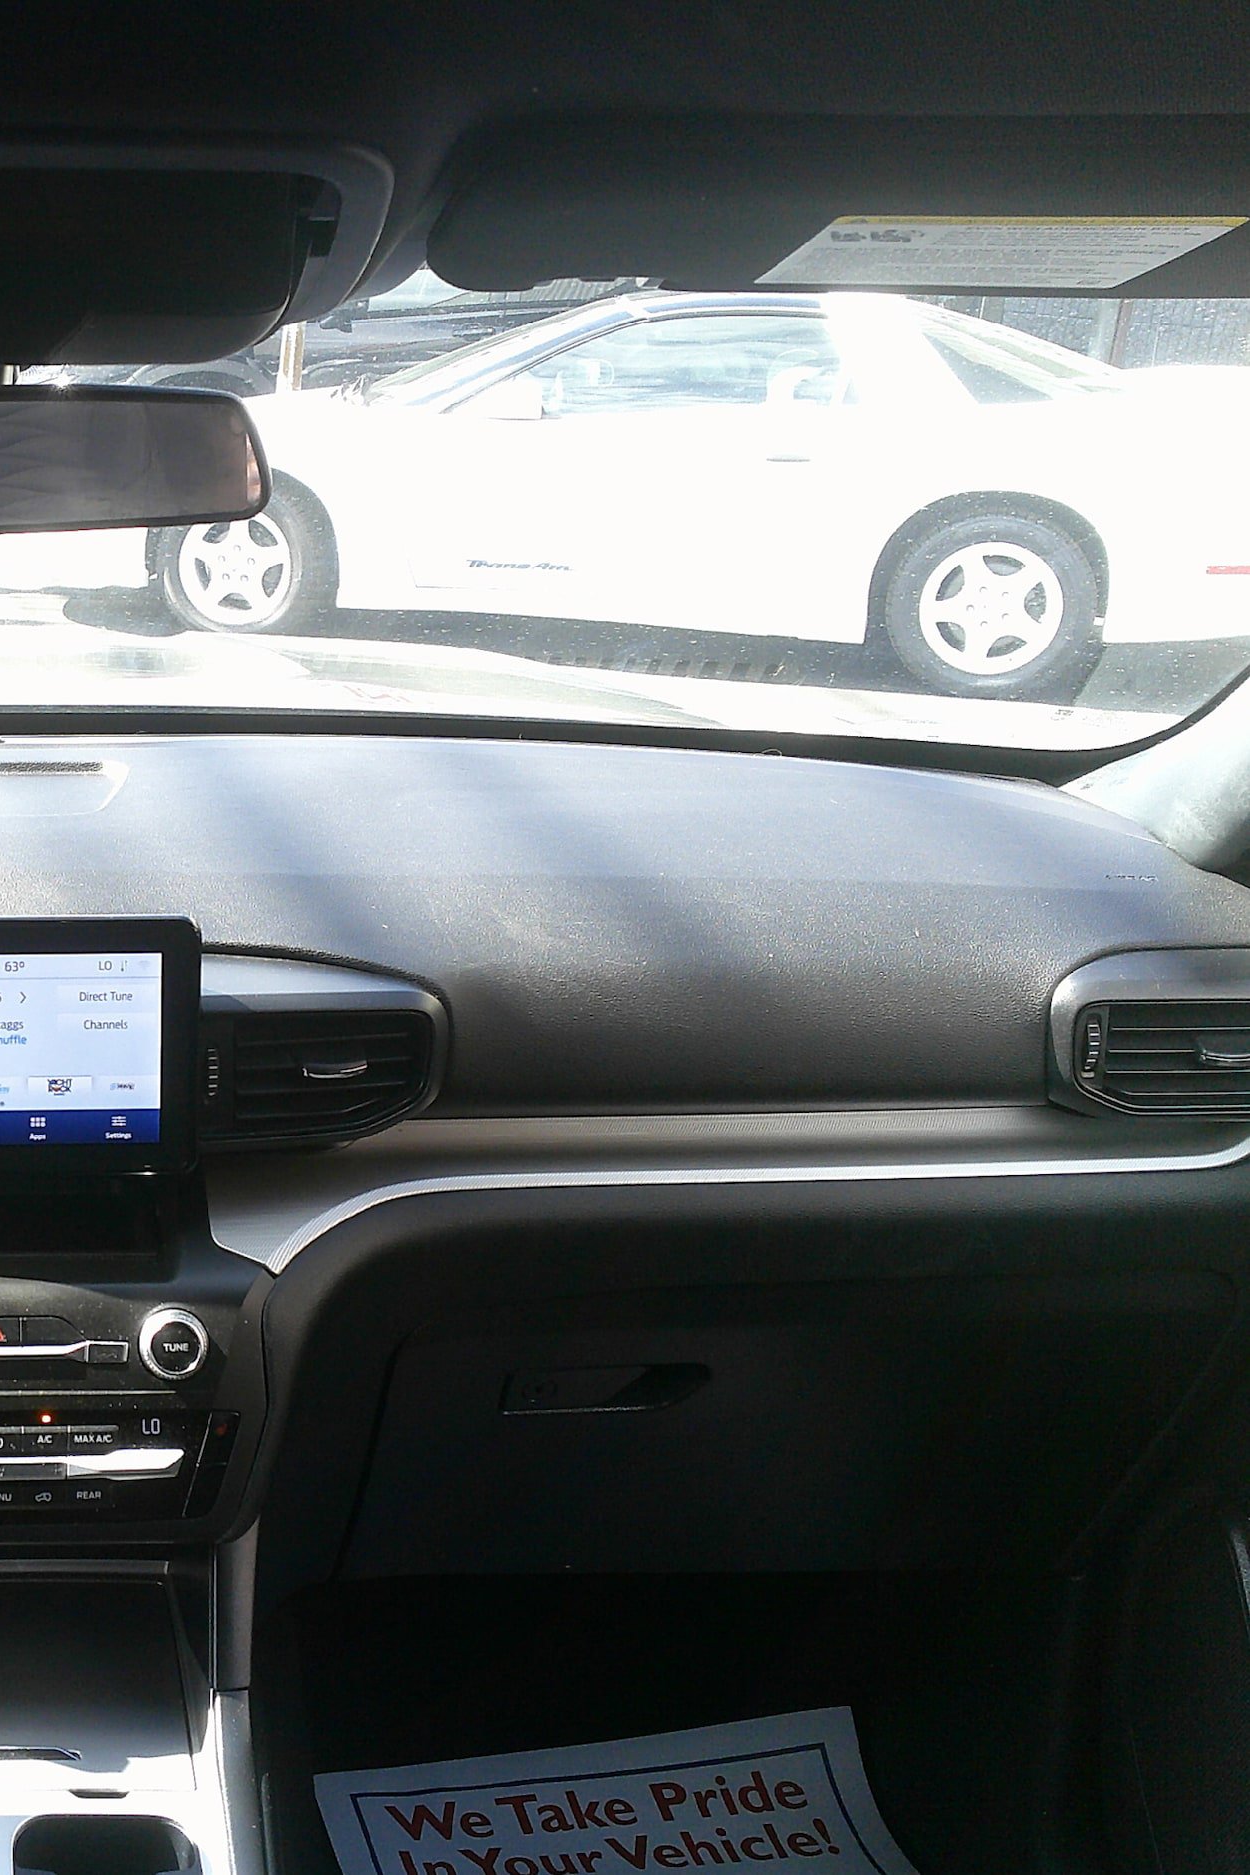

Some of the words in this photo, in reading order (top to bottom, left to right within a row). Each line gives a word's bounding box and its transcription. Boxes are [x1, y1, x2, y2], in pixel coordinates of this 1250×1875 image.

[98, 960, 113, 971] LO
[79, 991, 107, 1002] Direct
[110, 991, 133, 1002] Tune
[83, 1019, 128, 1030] Channels
[28, 1131, 47, 1142] Apps
[104, 1130, 132, 1141] Settings
[162, 1342, 189, 1352] TUNE
[142, 1418, 161, 1435] LO
[36, 1435, 53, 1444] A/C
[74, 1435, 95, 1444] MAX
[96, 1434, 113, 1444] A/C
[76, 1491, 102, 1501] REAR
[384, 1800, 493, 1842] We
[494, 1790, 638, 1835] Take
[648, 1770, 808, 1822] Pride
[458, 1845, 603, 1875] Your
[604, 1817, 841, 1870] Vehicle!
